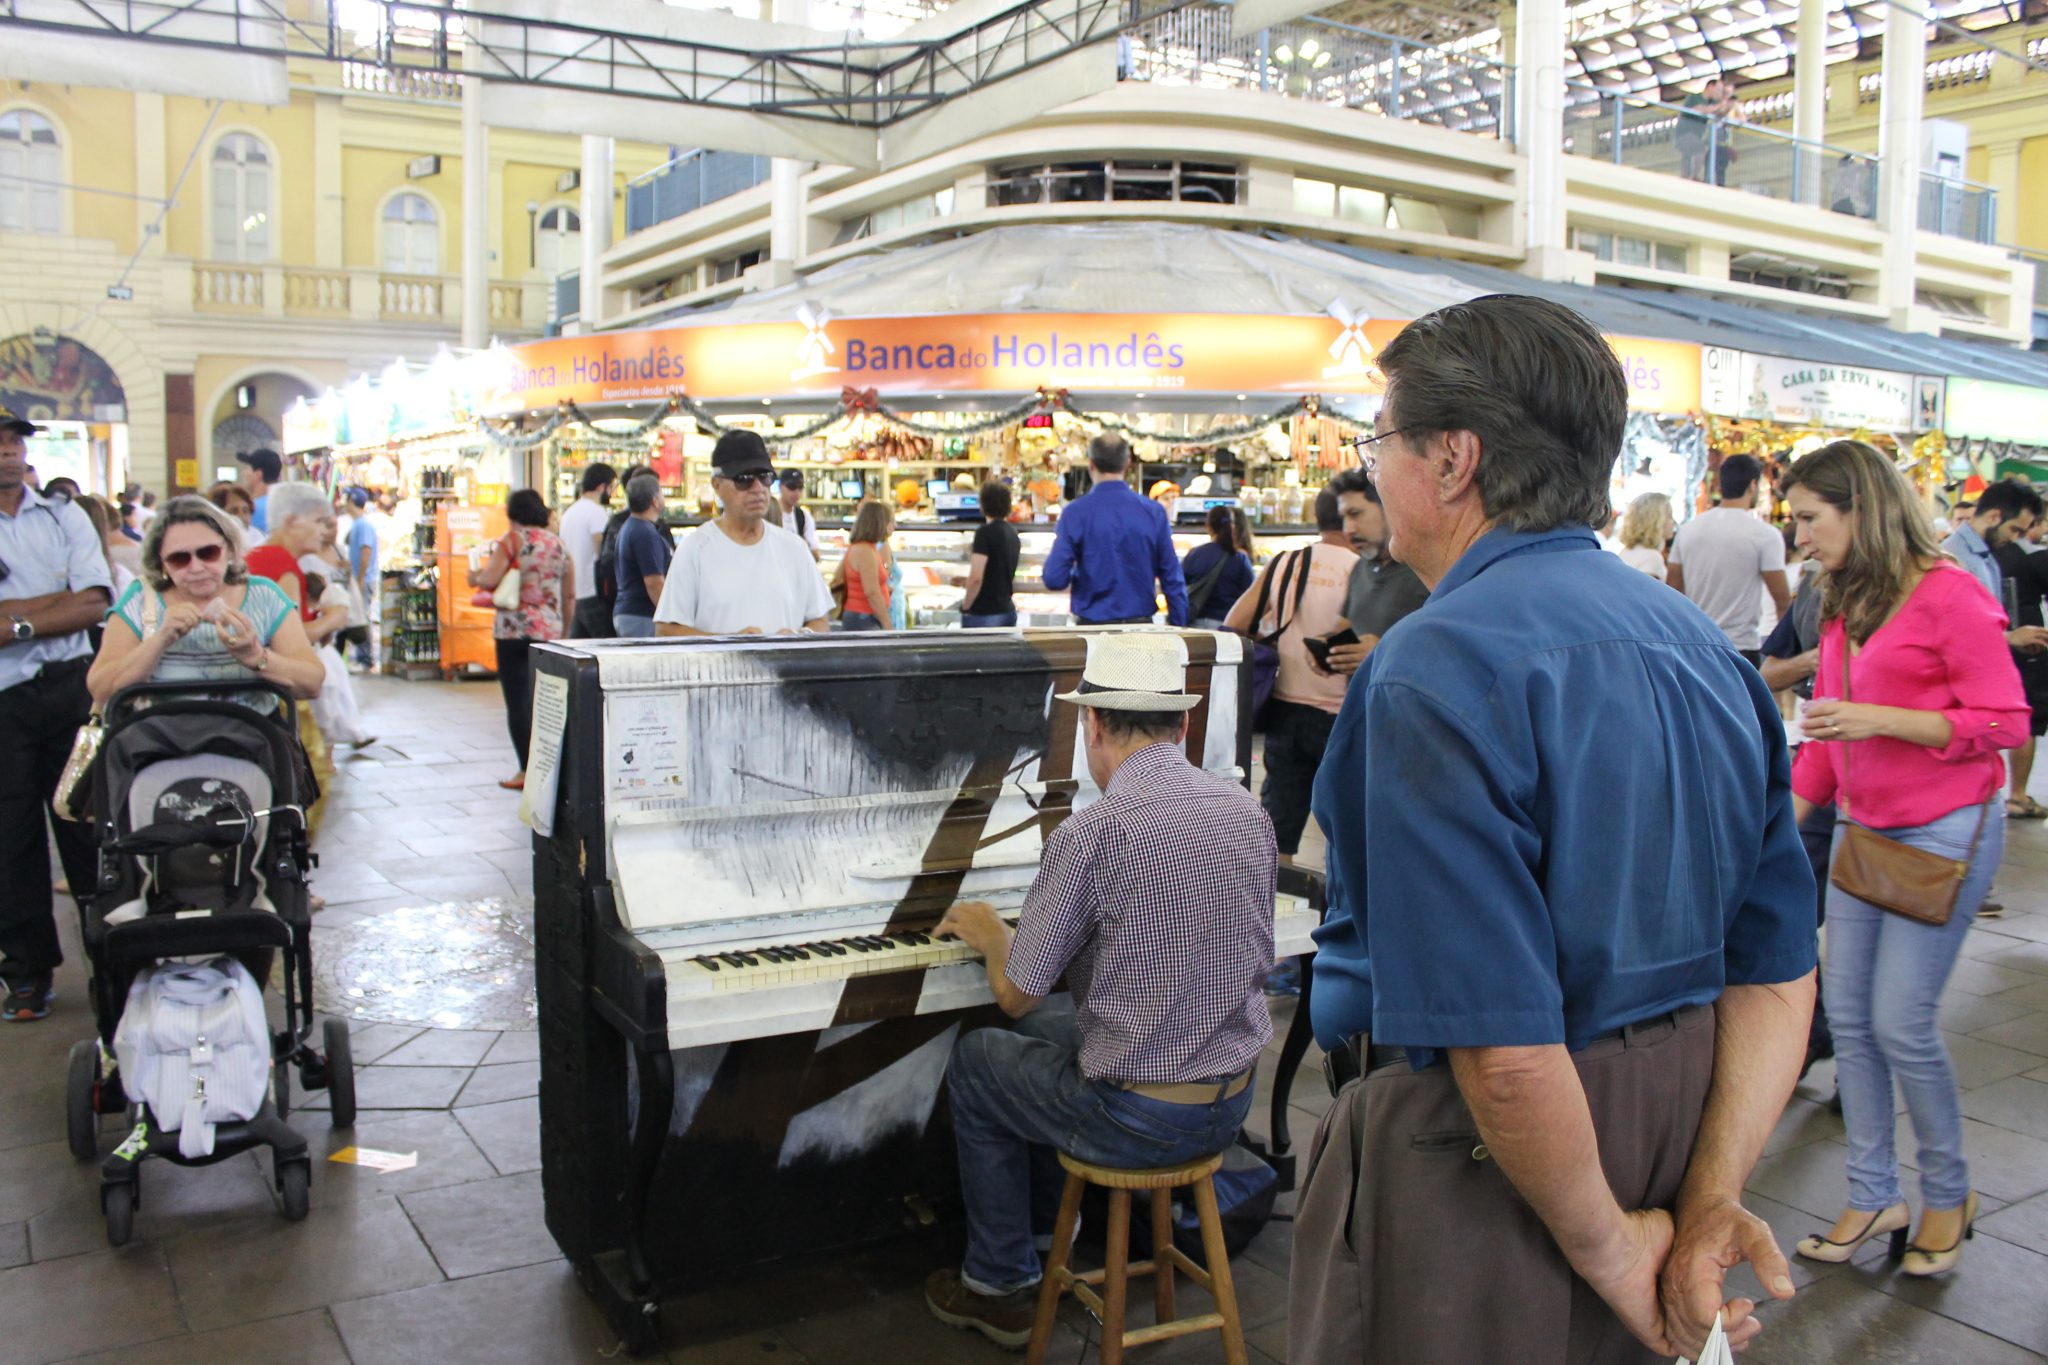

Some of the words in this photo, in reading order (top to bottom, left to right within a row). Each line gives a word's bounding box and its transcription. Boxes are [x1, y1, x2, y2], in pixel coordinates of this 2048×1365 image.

[511, 364, 556, 391] Banca
[573, 345, 685, 384] Holandês
[845, 338, 956, 371] Banca
[959, 347, 988, 369] do
[992, 332, 1185, 369] Holandês
[1782, 369, 1814, 388] CASA
[1819, 368, 1835, 382] DA
